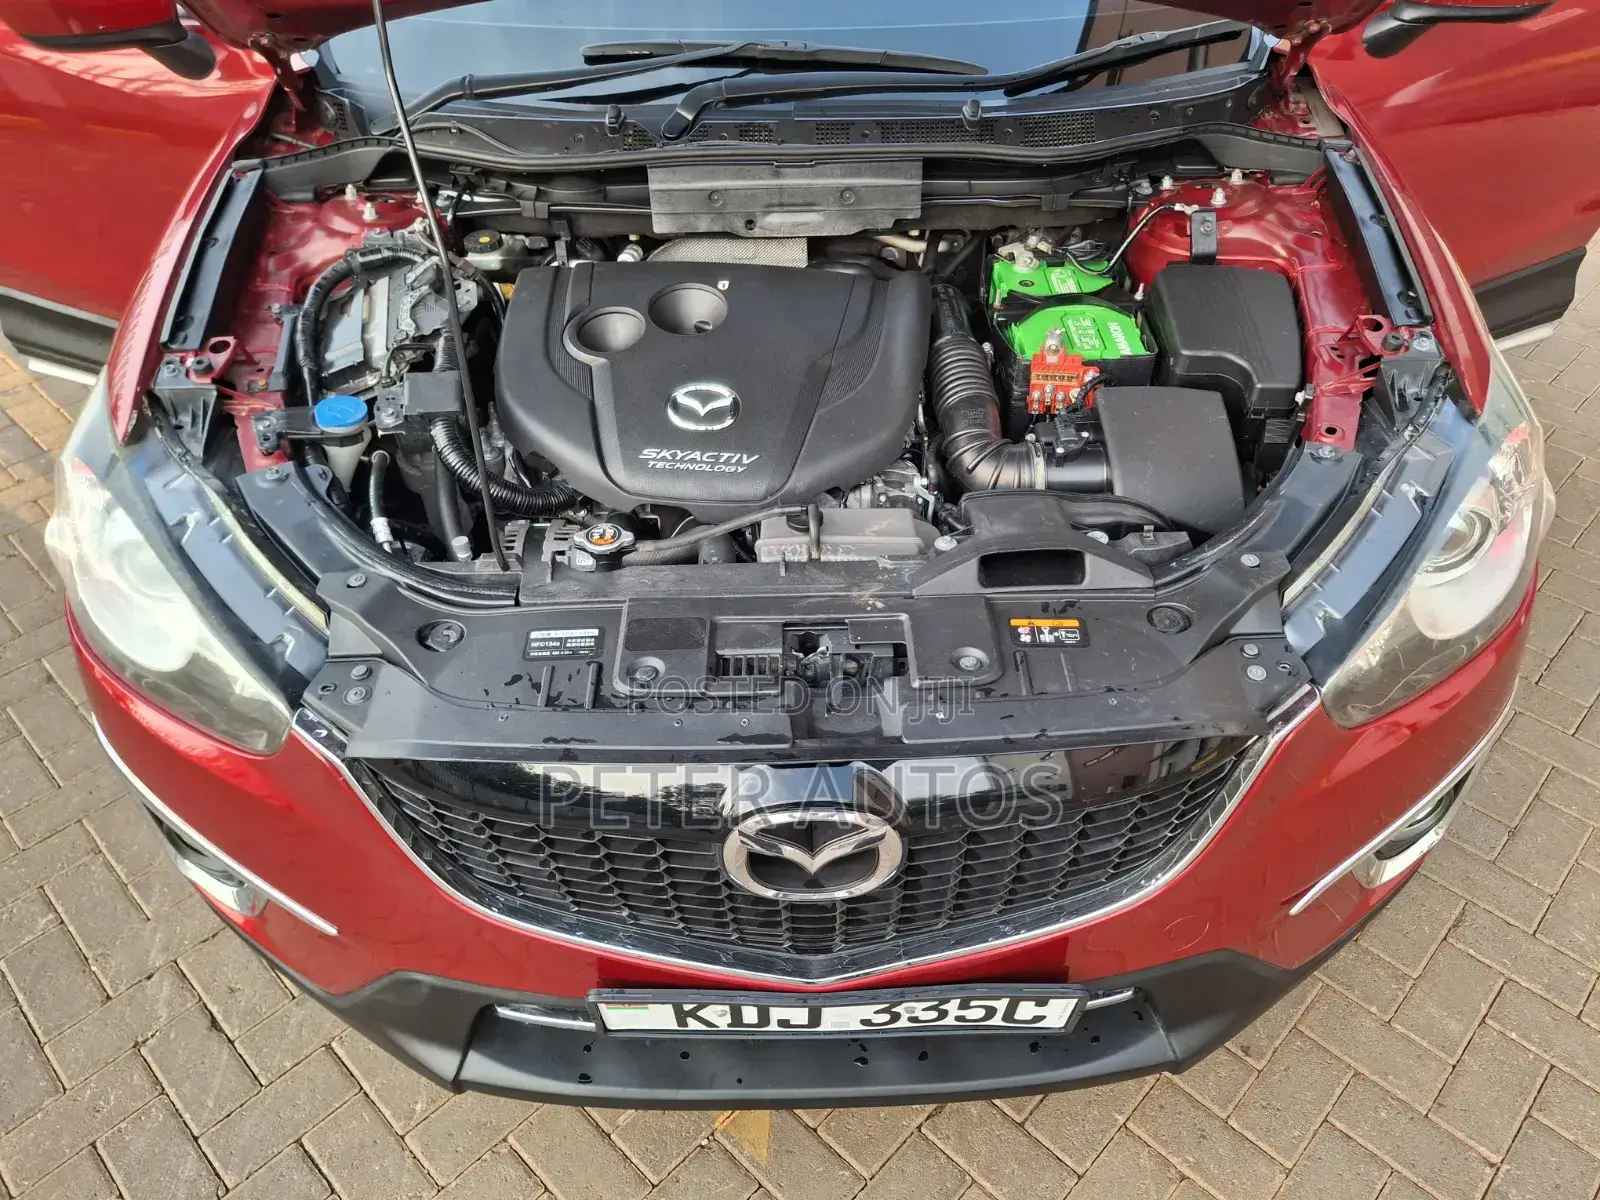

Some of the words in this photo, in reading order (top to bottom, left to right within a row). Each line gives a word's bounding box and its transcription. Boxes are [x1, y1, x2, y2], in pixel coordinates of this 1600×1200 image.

[638, 448, 760, 465] SKYACTIV
[647, 460, 748, 473] TECHNOLOGY
[672, 1003, 822, 1029] KDJ
[860, 998, 1051, 1027] 335C
